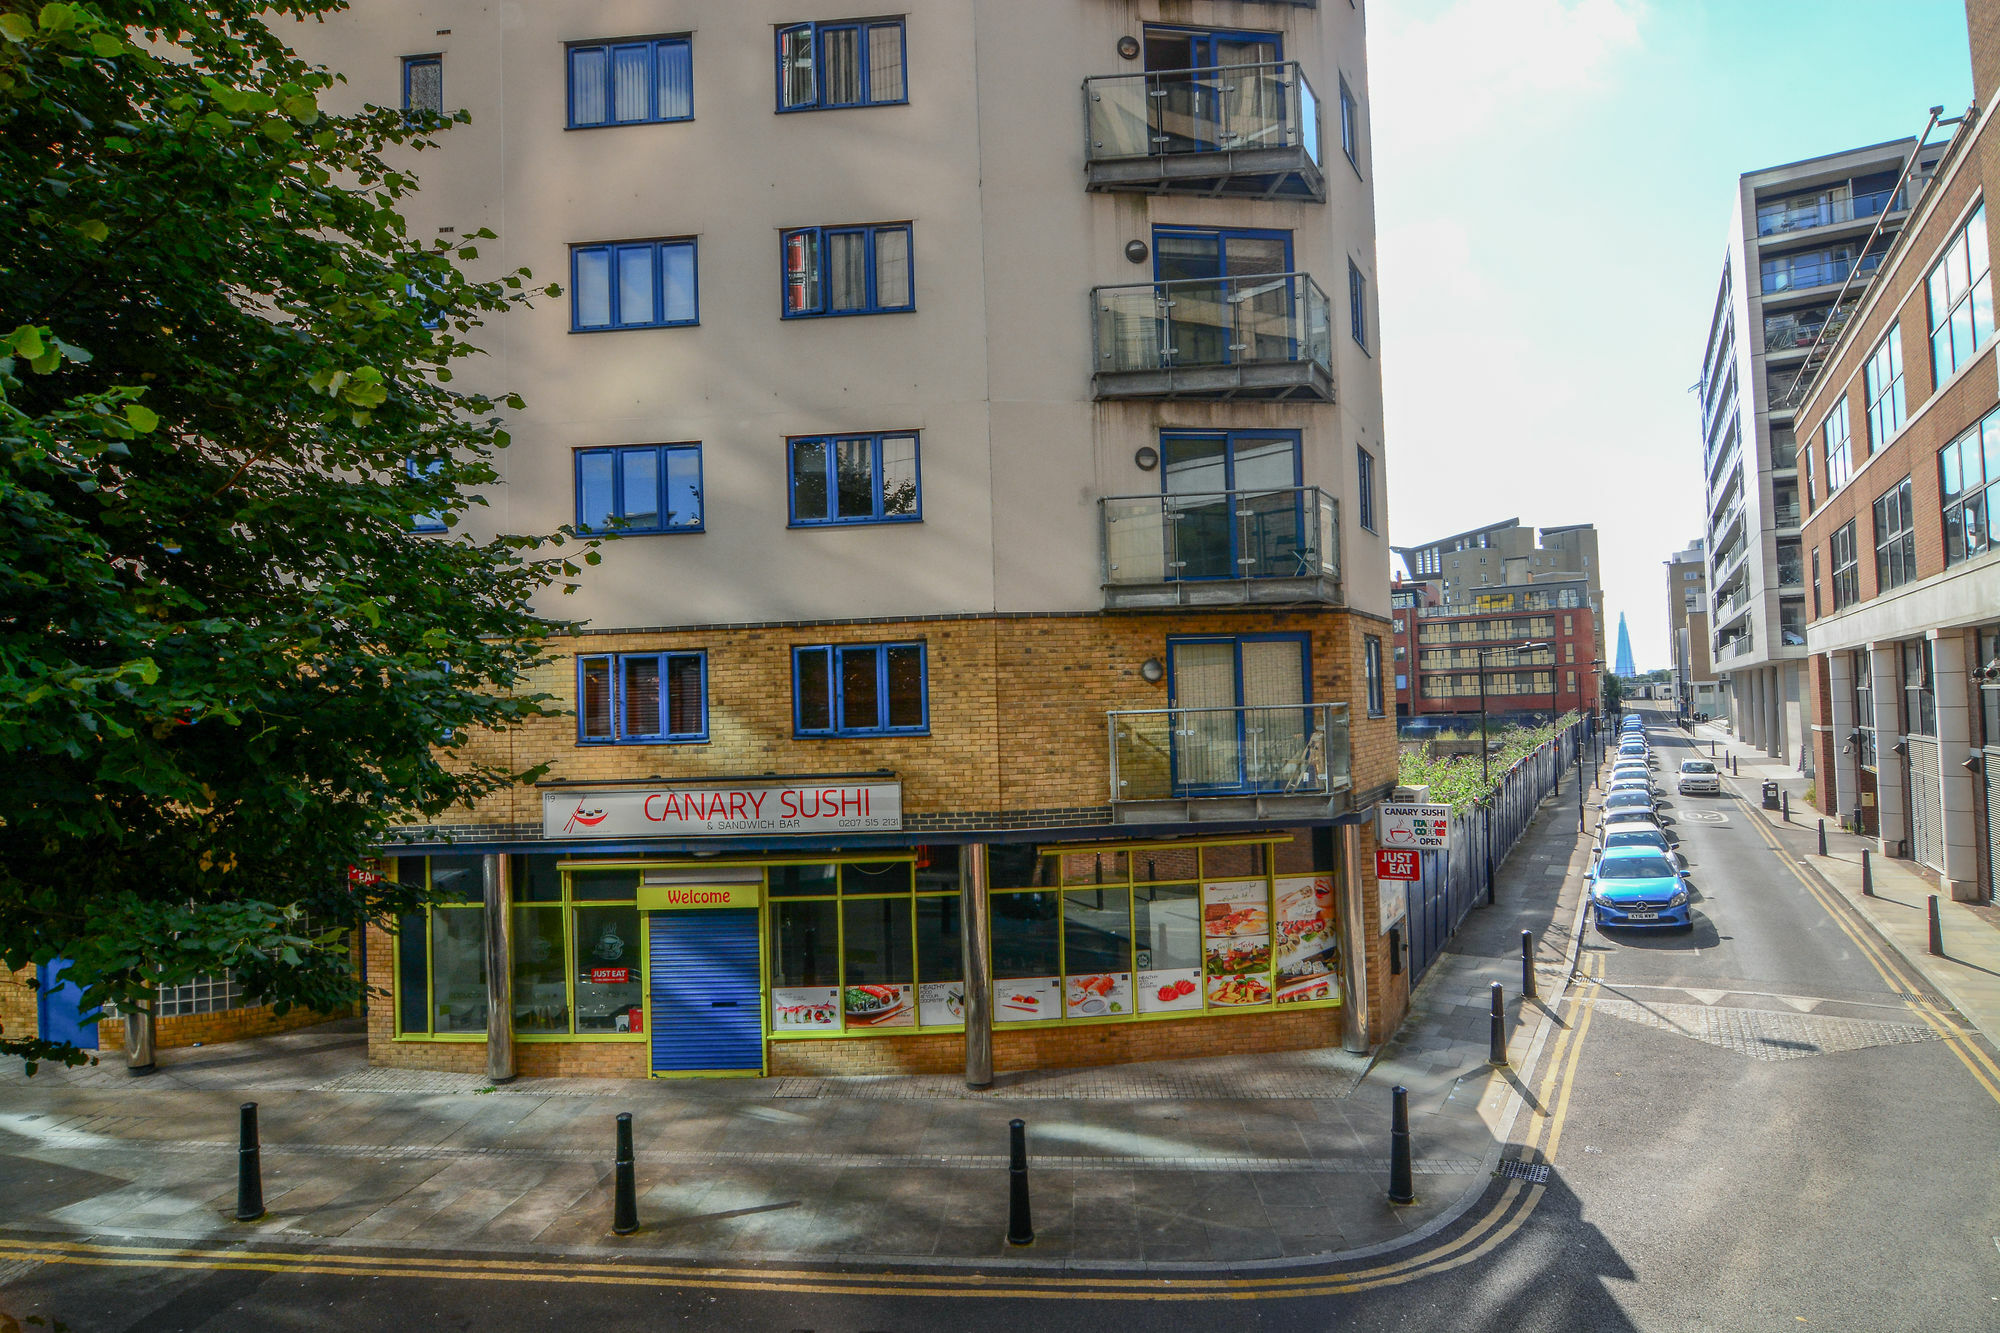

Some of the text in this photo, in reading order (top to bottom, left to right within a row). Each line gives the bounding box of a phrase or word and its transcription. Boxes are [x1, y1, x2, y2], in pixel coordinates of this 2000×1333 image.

[644, 789, 870, 822] CANARY SUSHI
[1384, 808, 1446, 816] CANARY SUSHI
[707, 819, 800, 830] & SANDWICH BAR
[838, 818, 861, 827] 0207
[1413, 819, 1447, 828] ITALIAN
[1414, 828, 1446, 836] COFFEE
[1419, 837, 1442, 845] OPEN
[1381, 852, 1413, 864] JUST
[1389, 863, 1413, 874] EAT
[667, 889, 731, 905] Welcome
